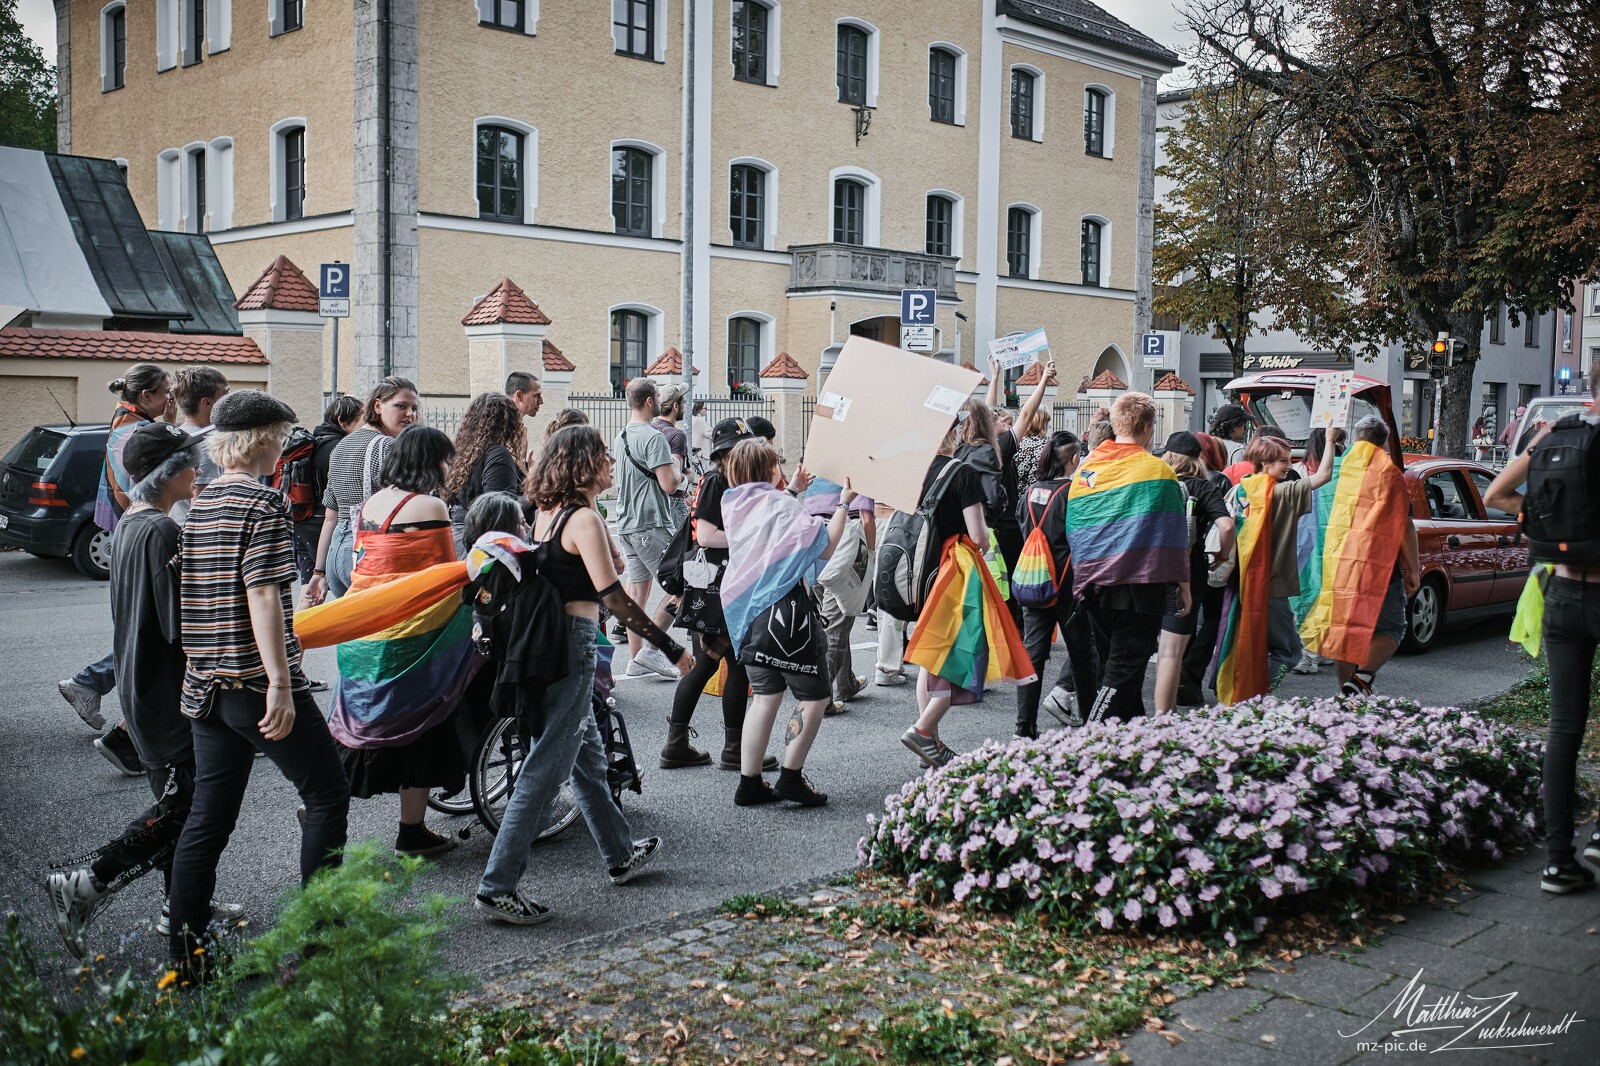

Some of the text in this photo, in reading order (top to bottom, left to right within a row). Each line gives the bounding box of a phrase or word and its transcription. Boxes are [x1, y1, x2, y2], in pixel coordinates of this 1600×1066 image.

[326, 267, 343, 294] P
[908, 293, 928, 321] P
[1147, 336, 1160, 354] P
[1258, 355, 1304, 369] Tchibo
[754, 651, 819, 675] CYBERHEX
